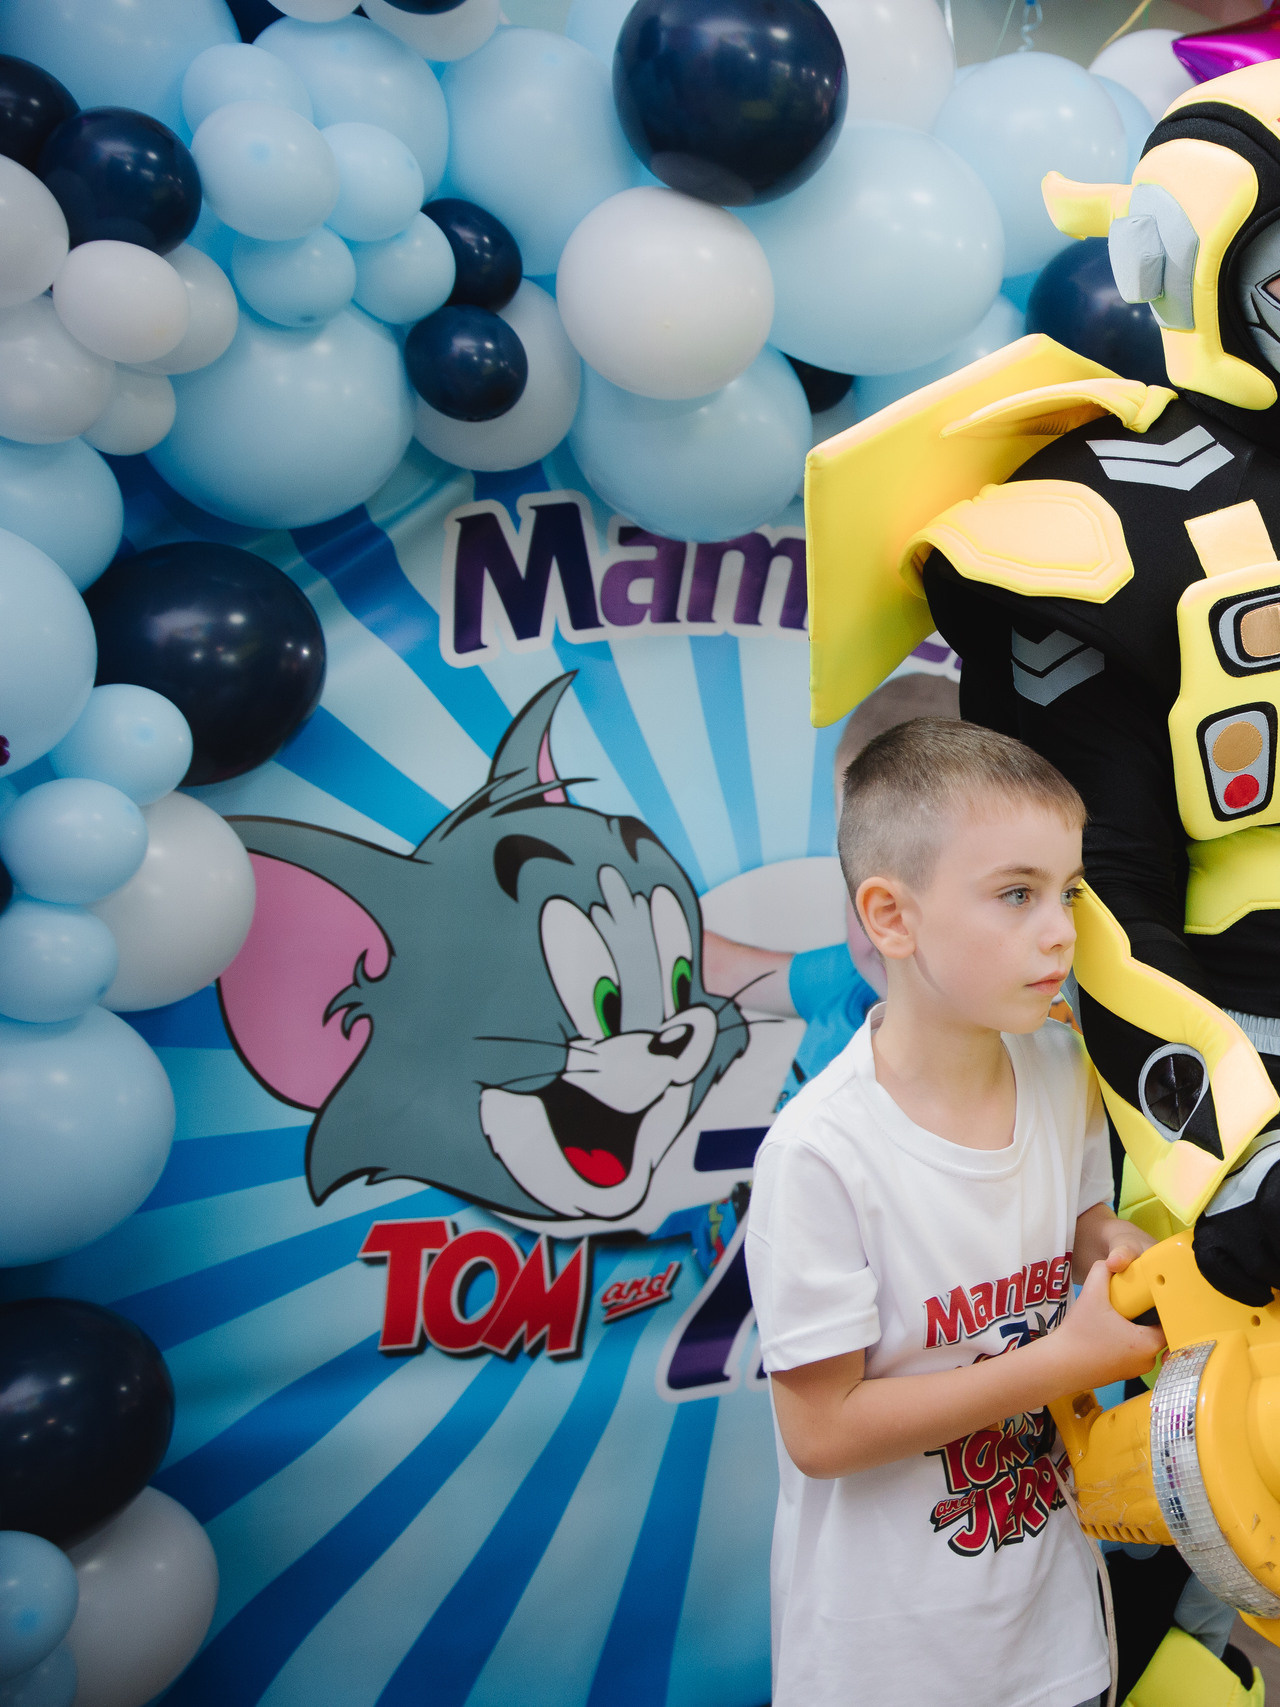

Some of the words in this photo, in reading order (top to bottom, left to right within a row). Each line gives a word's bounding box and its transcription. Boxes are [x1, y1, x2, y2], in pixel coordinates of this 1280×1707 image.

[450, 500, 808, 656] Mam
[358, 1218, 590, 1360] TOM
[601, 1262, 681, 1323] and
[925, 1417, 1031, 1494] TOM
[931, 1489, 976, 1531] and
